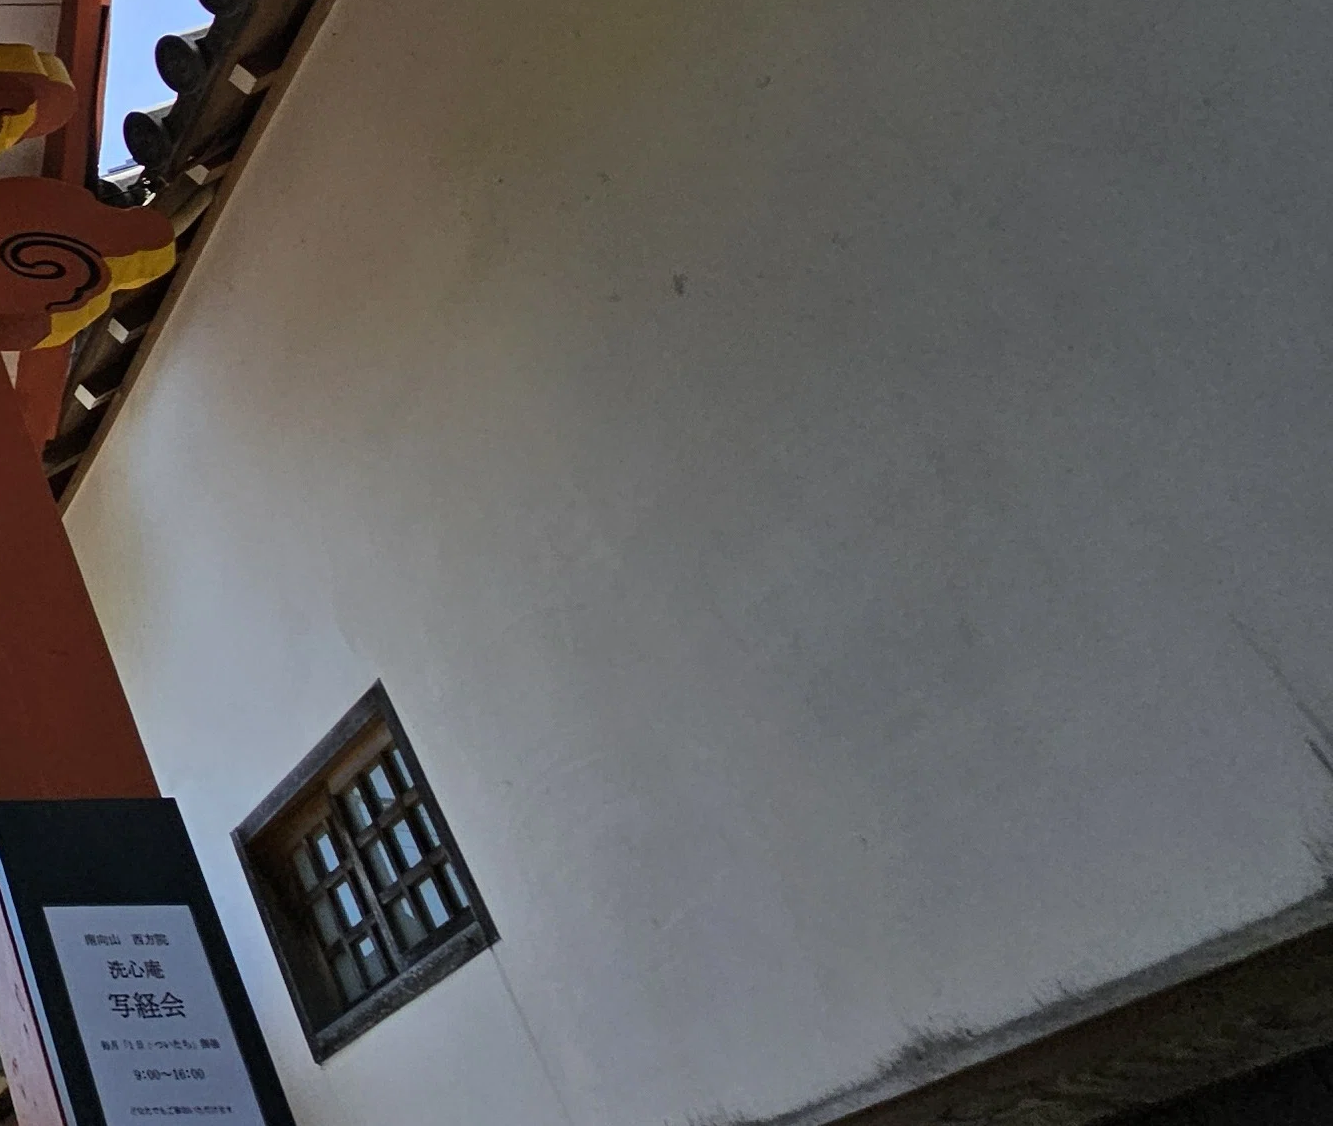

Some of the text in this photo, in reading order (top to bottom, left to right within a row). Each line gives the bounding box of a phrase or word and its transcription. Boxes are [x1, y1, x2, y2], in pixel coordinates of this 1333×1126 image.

[131, 933, 169, 946] 西方院
[107, 959, 165, 979] 洗心庵
[108, 991, 186, 1019] 写経会
